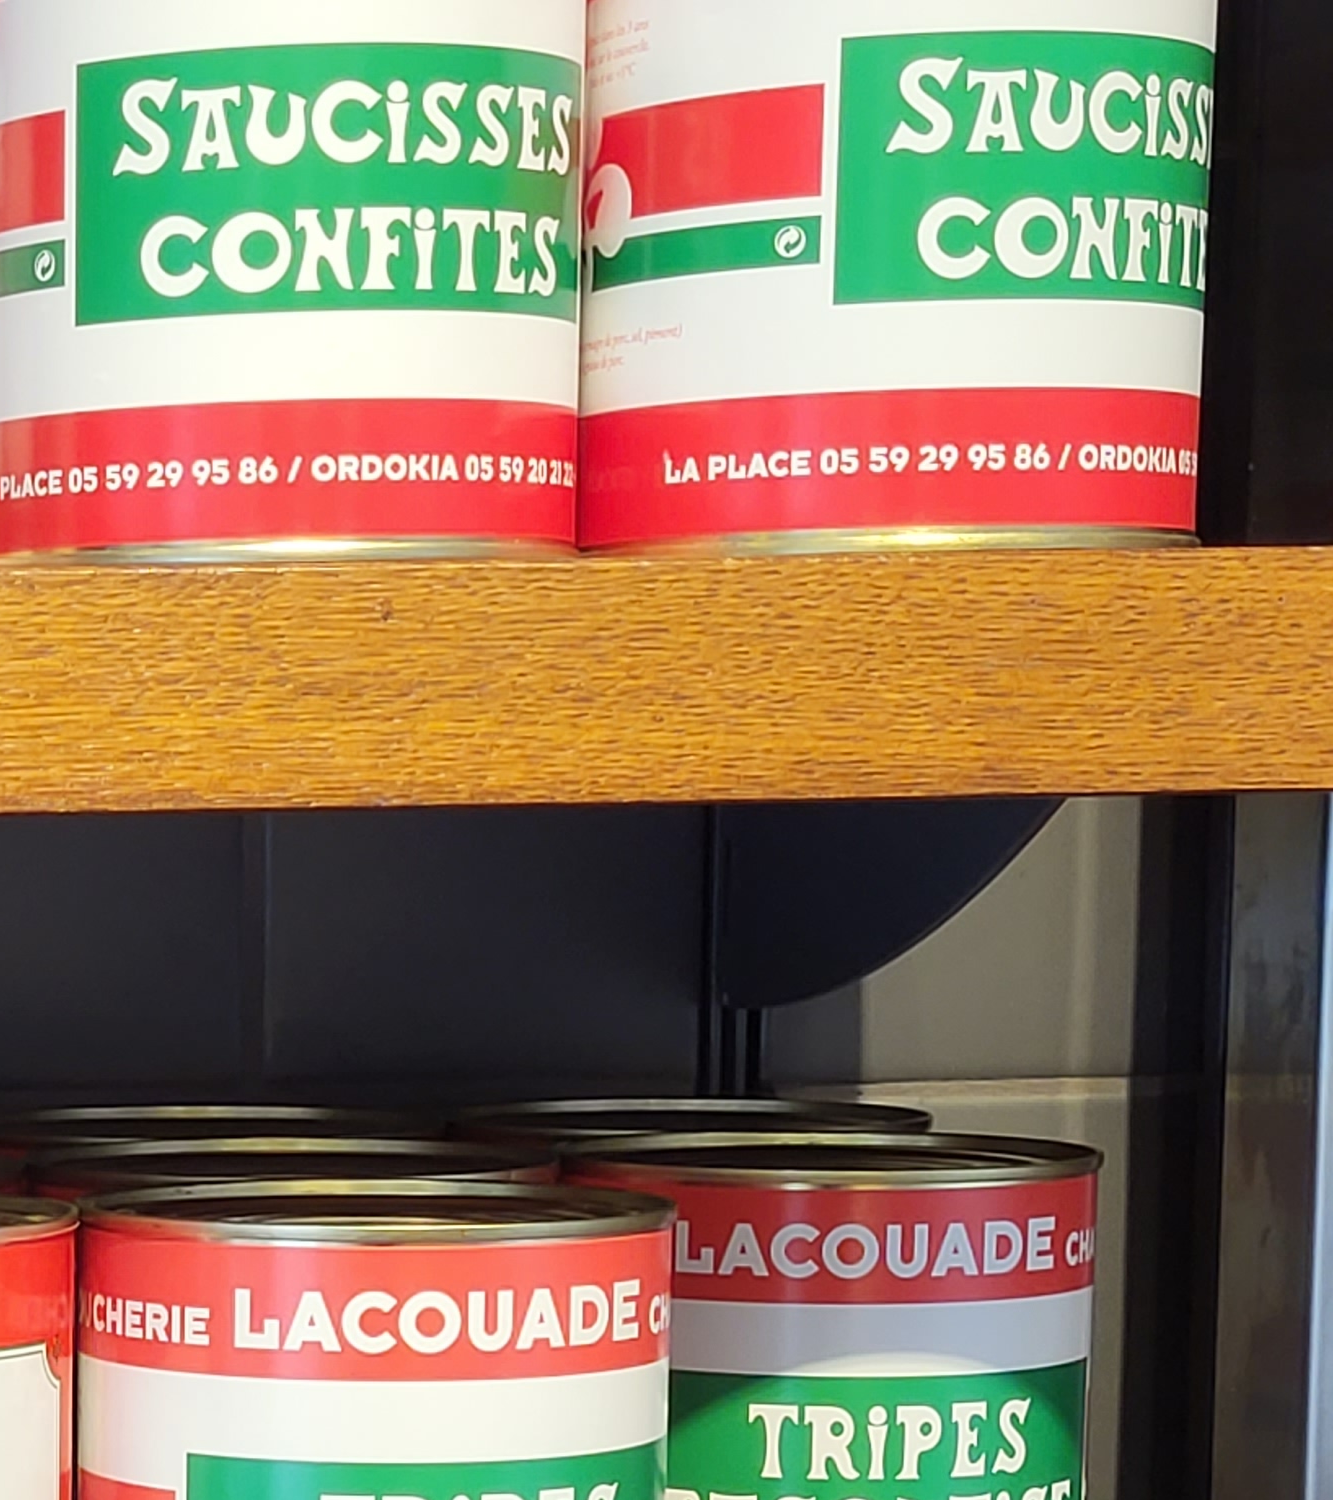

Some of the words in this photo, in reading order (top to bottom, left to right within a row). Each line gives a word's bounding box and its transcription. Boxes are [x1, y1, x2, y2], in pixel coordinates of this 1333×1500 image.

[0, 470, 63, 501] PLACE
[67, 466, 98, 494] 05
[105, 464, 139, 492] 59
[146, 460, 184, 489] 29
[192, 458, 231, 486] 95
[238, 456, 279, 484] 86
[310, 455, 460, 483] ORDOKIA
[464, 455, 495, 483] 05
[664, 458, 700, 484] LA
[708, 449, 812, 481] PLACE
[819, 447, 860, 475] 05
[868, 446, 911, 473] 59
[917, 444, 959, 472] 29
[967, 443, 1007, 473] 95
[1014, 443, 1051, 471] 86
[1077, 443, 1177, 476] ORDOKIA
[674, 1216, 1057, 1281] LACOUADE
[232, 1279, 641, 1356] LACOUADE
